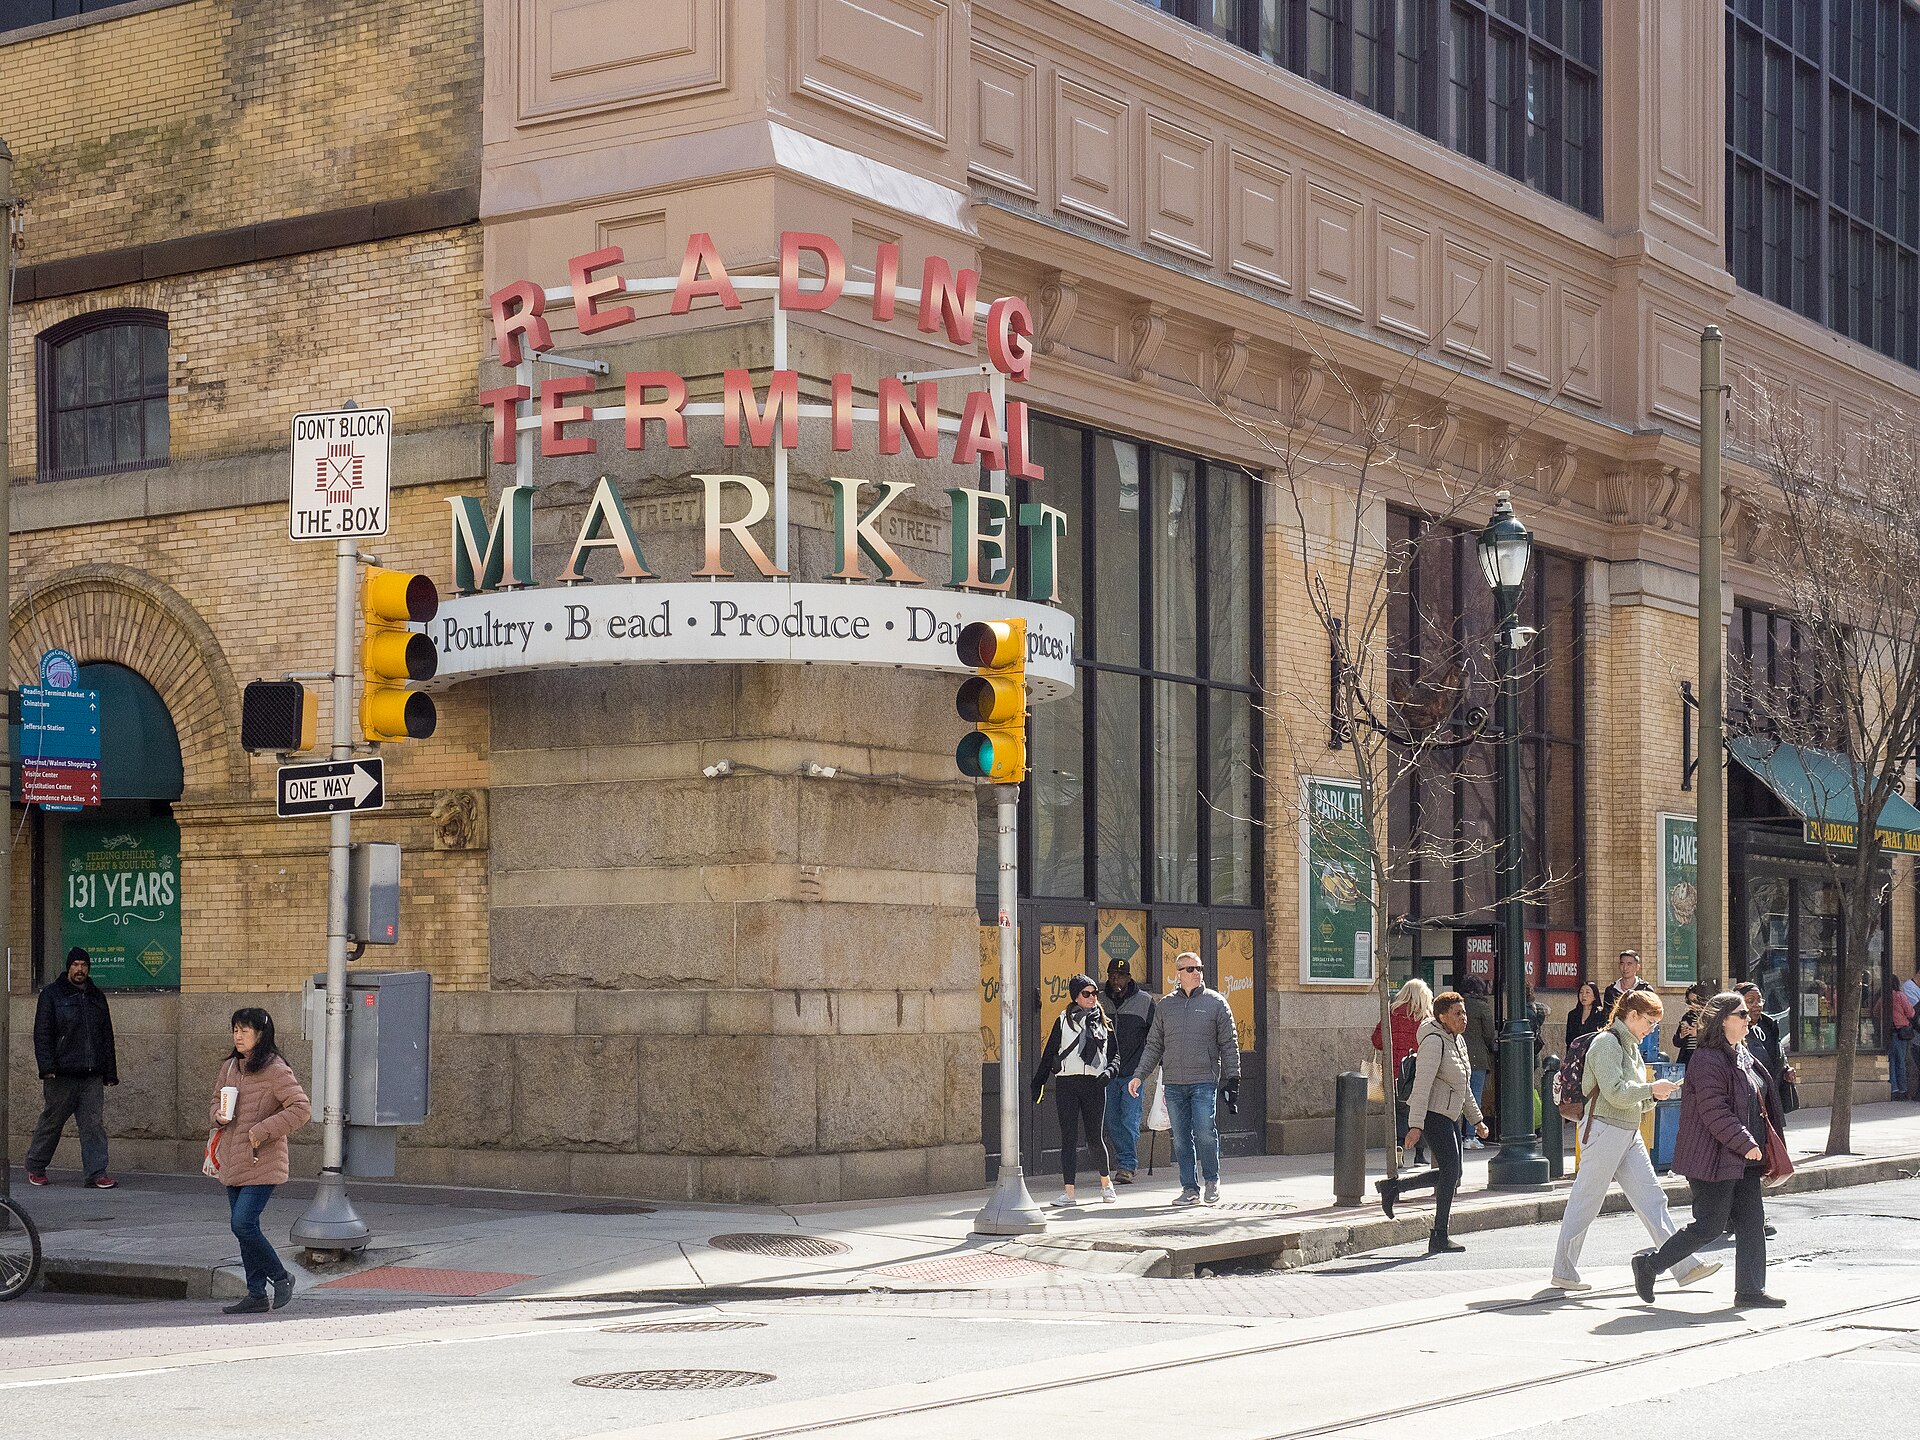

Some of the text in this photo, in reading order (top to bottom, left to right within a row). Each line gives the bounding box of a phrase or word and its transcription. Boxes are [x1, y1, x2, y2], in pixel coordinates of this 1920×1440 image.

[490, 231, 1034, 383] READING
[340, 414, 385, 438] BLOCK
[480, 369, 1045, 482] TERMINAL
[297, 506, 380, 534] THE BOX
[889, 516, 942, 546] STREET
[444, 474, 1069, 604] MARKET
[443, 610, 535, 653] Poultry
[564, 600, 673, 641] Bead
[710, 600, 870, 640] Produce
[906, 606, 962, 645] Dai
[1026, 623, 1064, 663] pices
[23, 688, 44, 697] Reading
[45, 689, 66, 697] Terminal
[23, 699, 50, 708] Chinatown
[23, 723, 65, 732] Jefferson Station
[67, 760, 91, 769] Shopping
[289, 776, 352, 801] ONE WAY
[25, 793, 60, 801] Independence
[60, 794, 72, 802] Park
[1315, 788, 1346, 821] PARK
[86, 849, 155, 861] FEEDING PHILLY'S
[85, 860, 157, 871] HEART & SOUL FOR
[68, 871, 175, 908] 131 YEARS
[1466, 938, 1492, 953] SPARE
[1554, 942, 1567, 957] RIB
[1118, 960, 1125, 968] P
[1471, 959, 1489, 974] RIBS
[1547, 962, 1578, 976] ANDWICHES
